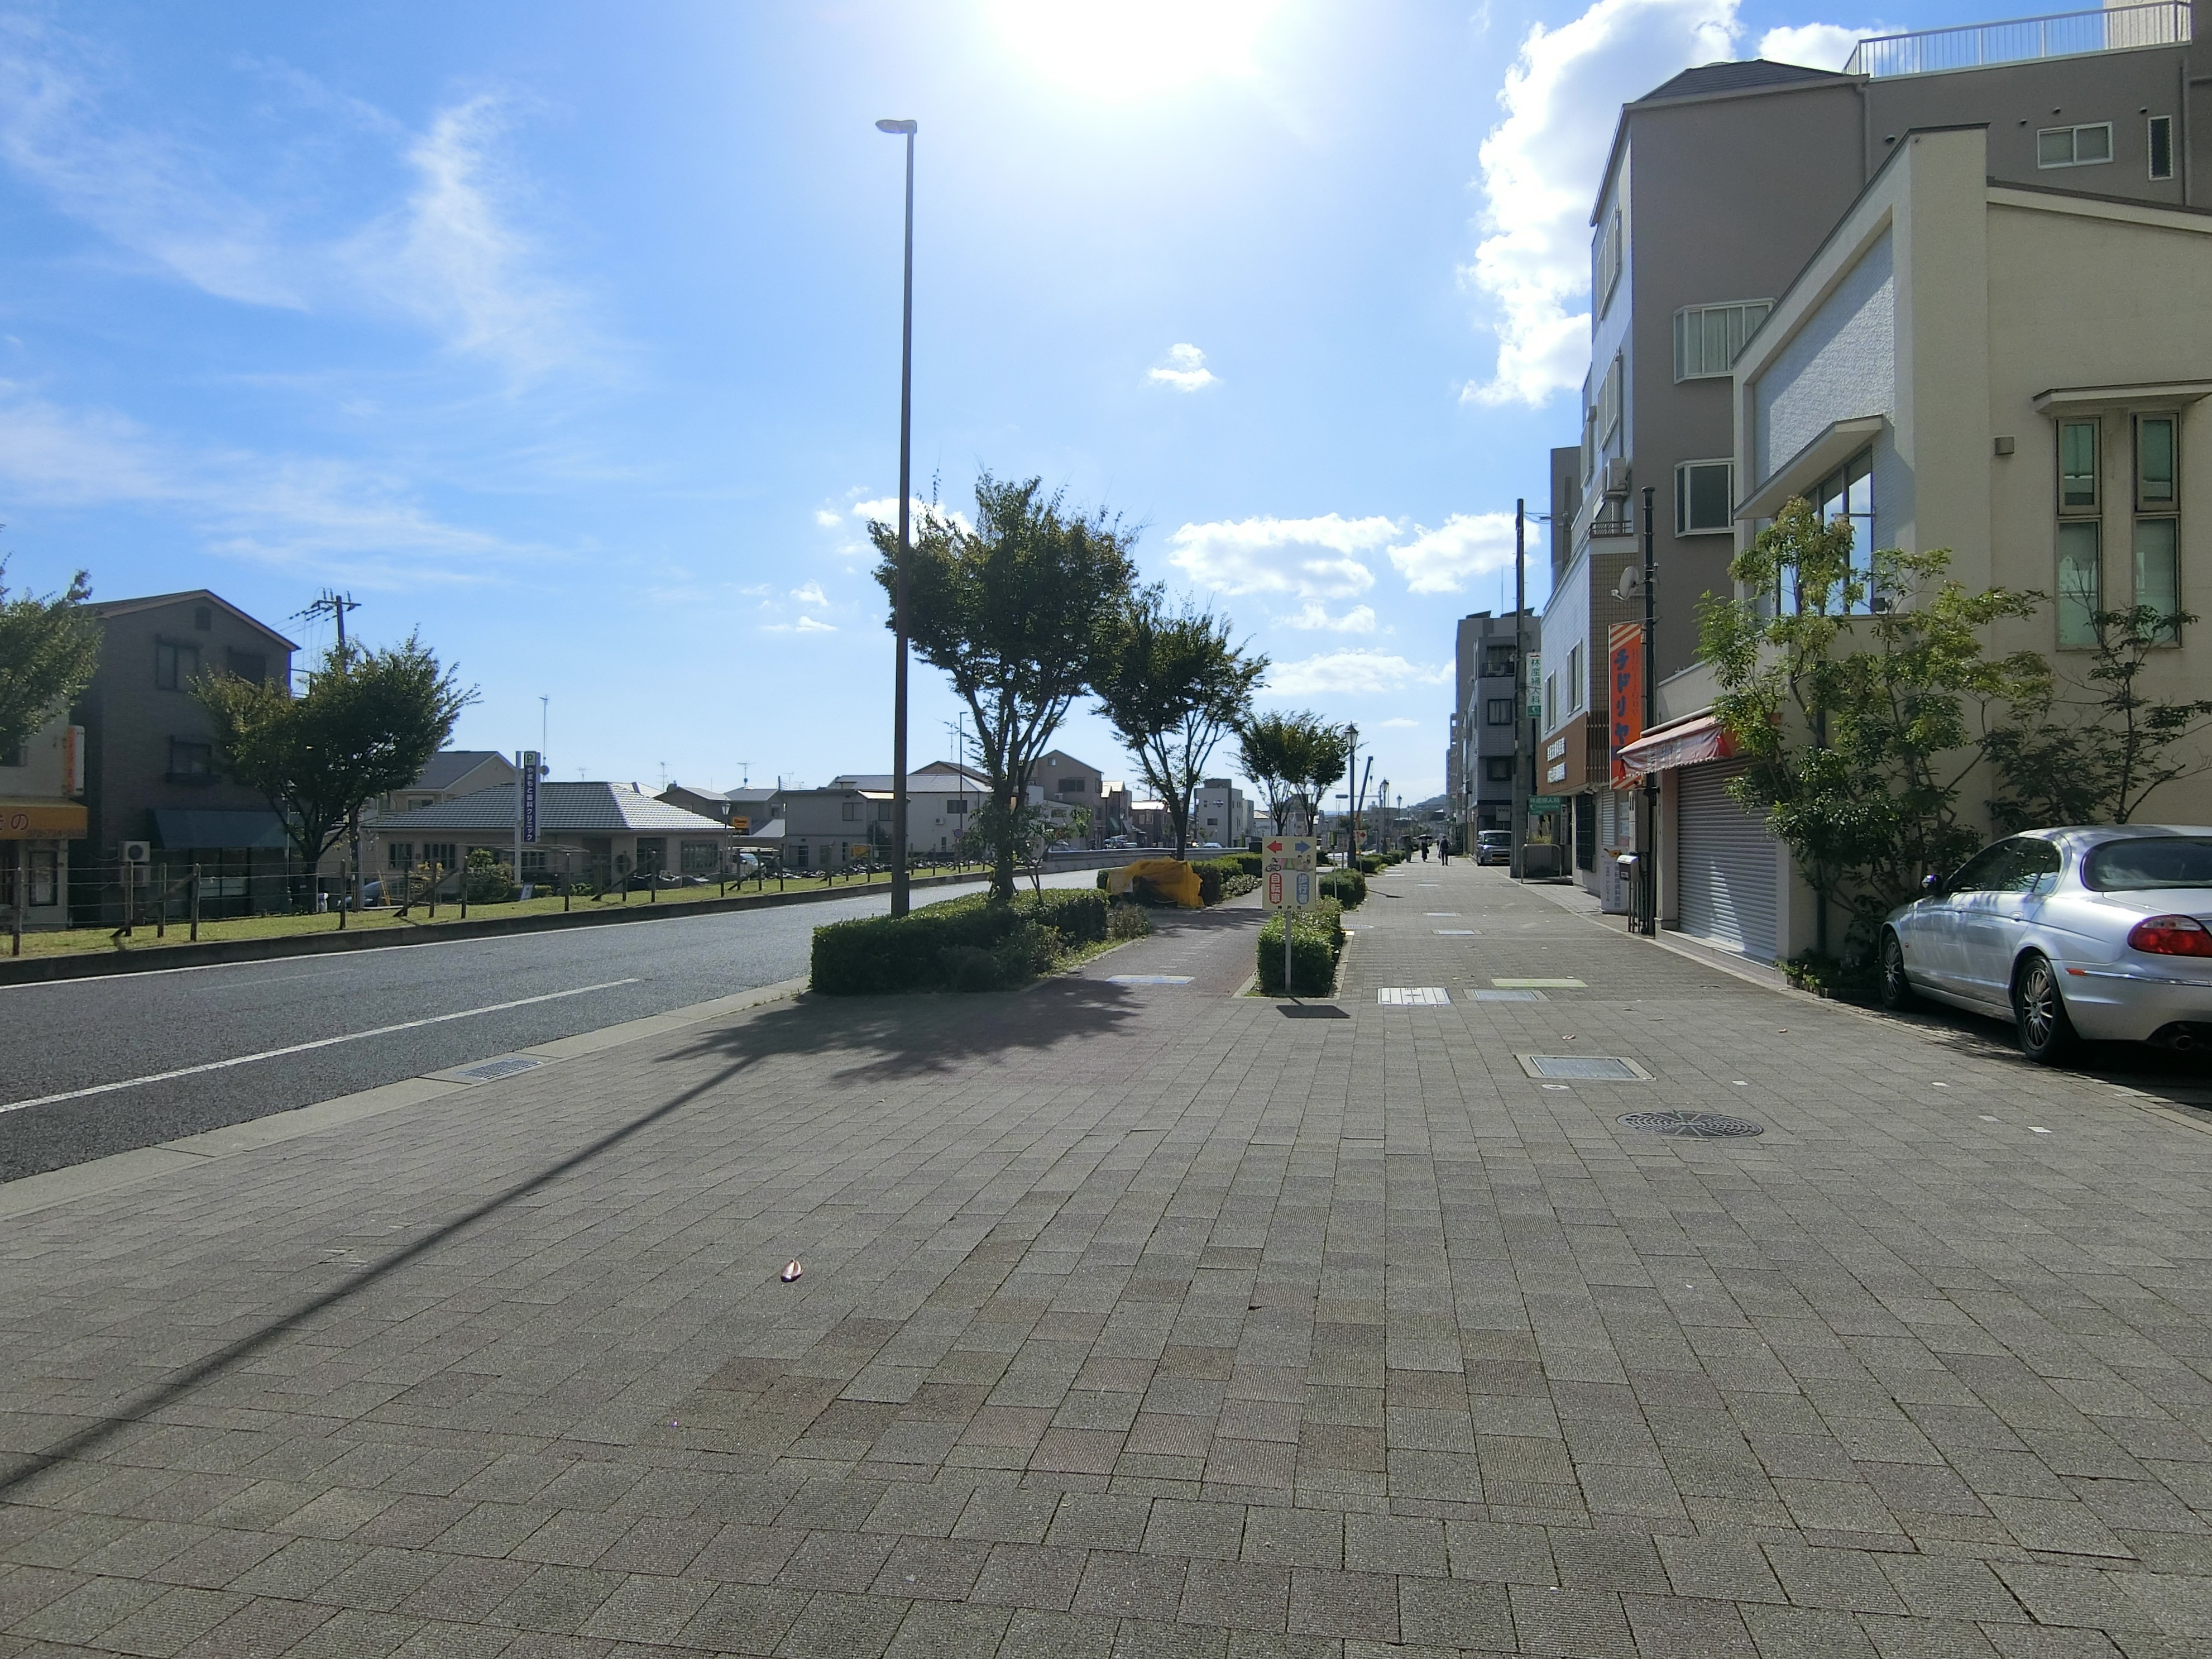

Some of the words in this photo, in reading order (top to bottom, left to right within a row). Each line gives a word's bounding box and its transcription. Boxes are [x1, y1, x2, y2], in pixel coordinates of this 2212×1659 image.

[1531, 659, 1540, 704] 林産婦人科
[1614, 648, 1631, 744] チドリヤ
[1271, 874, 1281, 902] 自転車
[1299, 873, 1308, 903] 歩行者
